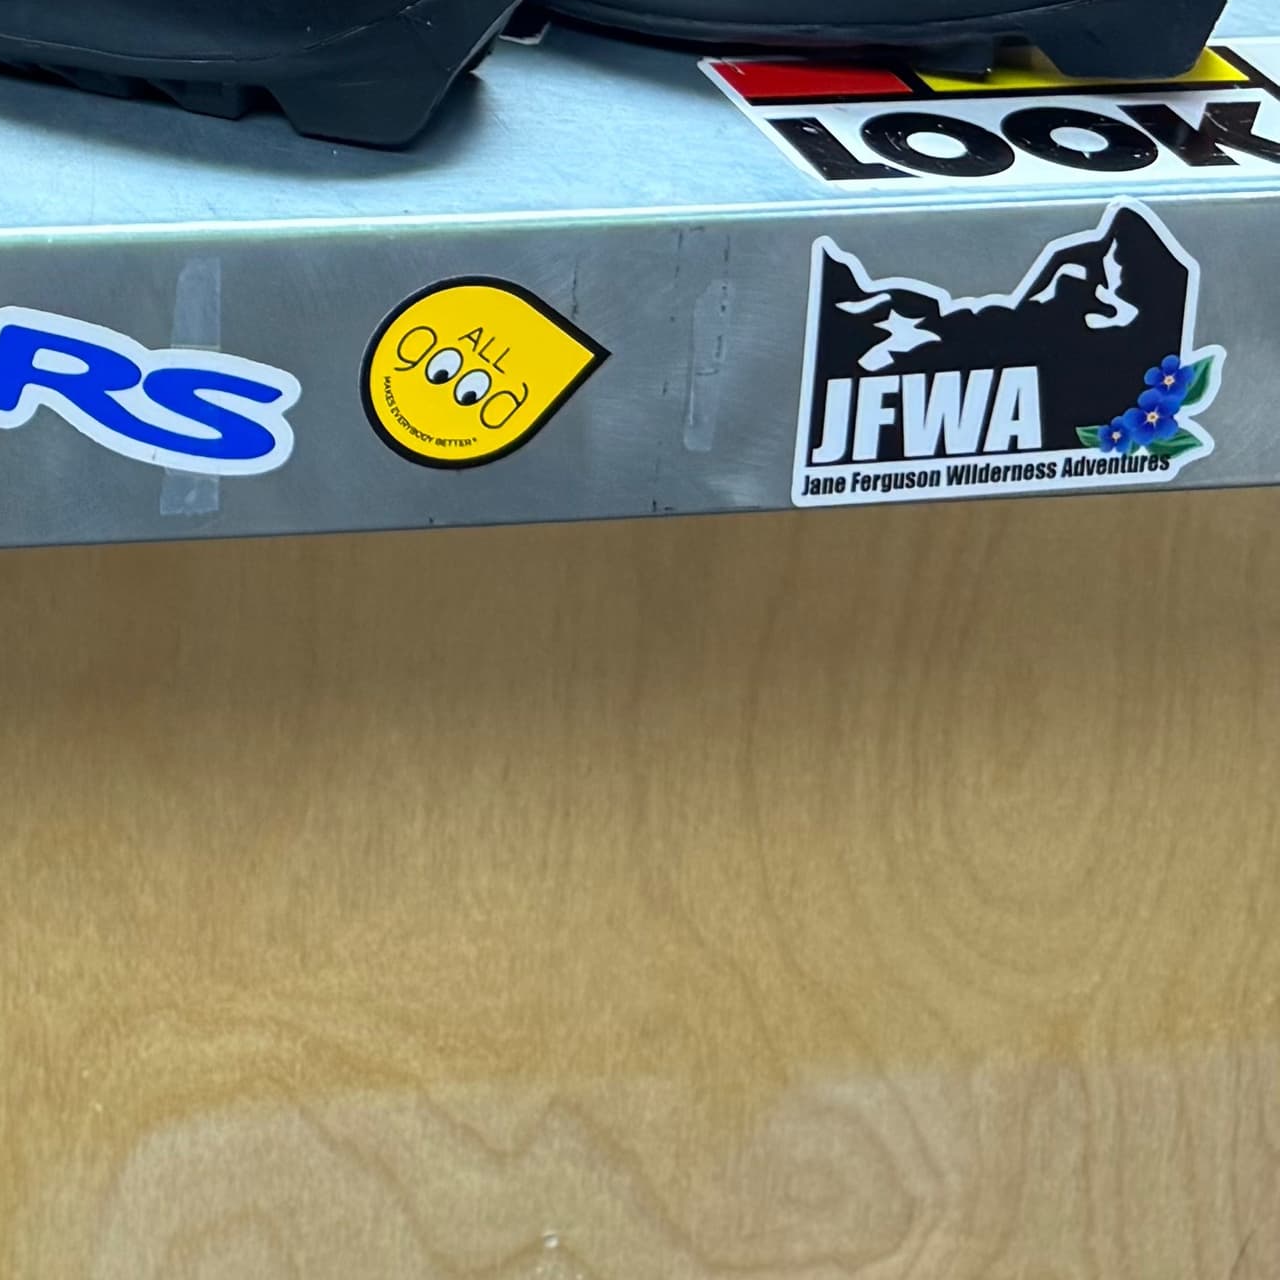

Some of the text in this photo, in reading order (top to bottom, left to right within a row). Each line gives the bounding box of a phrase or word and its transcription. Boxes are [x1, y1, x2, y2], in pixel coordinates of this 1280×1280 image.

[765, 101, 1280, 181] LOOK
[394, 325, 529, 430] good
[458, 326, 510, 375] ALL
[812, 366, 1042, 465] JFWA
[802, 453, 1171, 496] Jane Ferguson Wilderness Adventures
